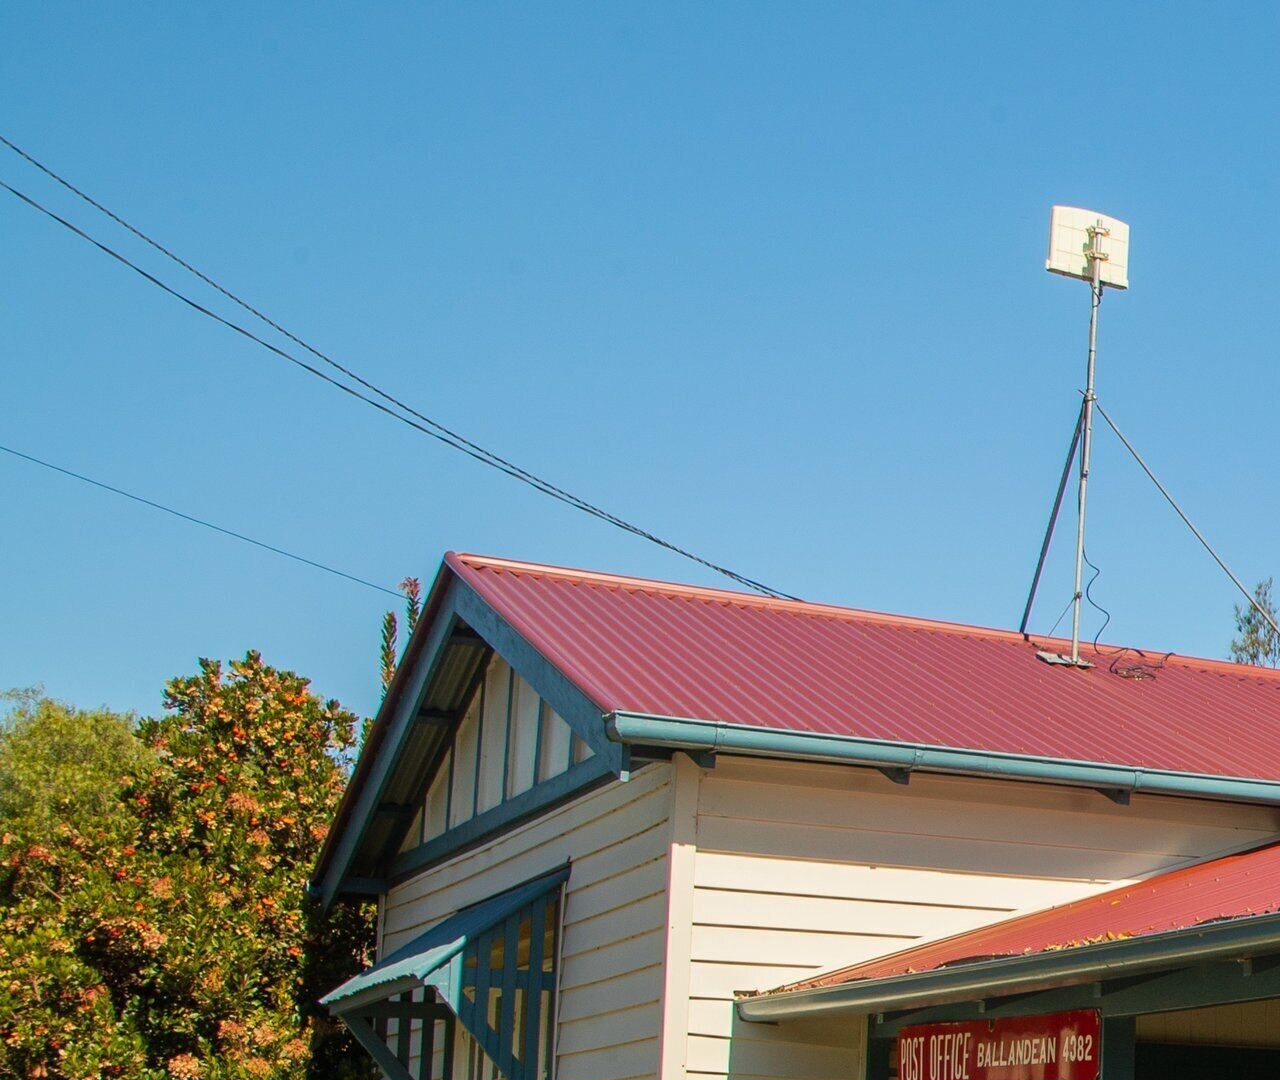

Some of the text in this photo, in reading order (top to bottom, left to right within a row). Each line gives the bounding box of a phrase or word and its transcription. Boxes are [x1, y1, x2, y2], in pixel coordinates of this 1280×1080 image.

[929, 1032, 972, 1080] OFFICE
[977, 1037, 1056, 1068] BALLANDEAN
[1062, 1034, 1093, 1062] 4382
